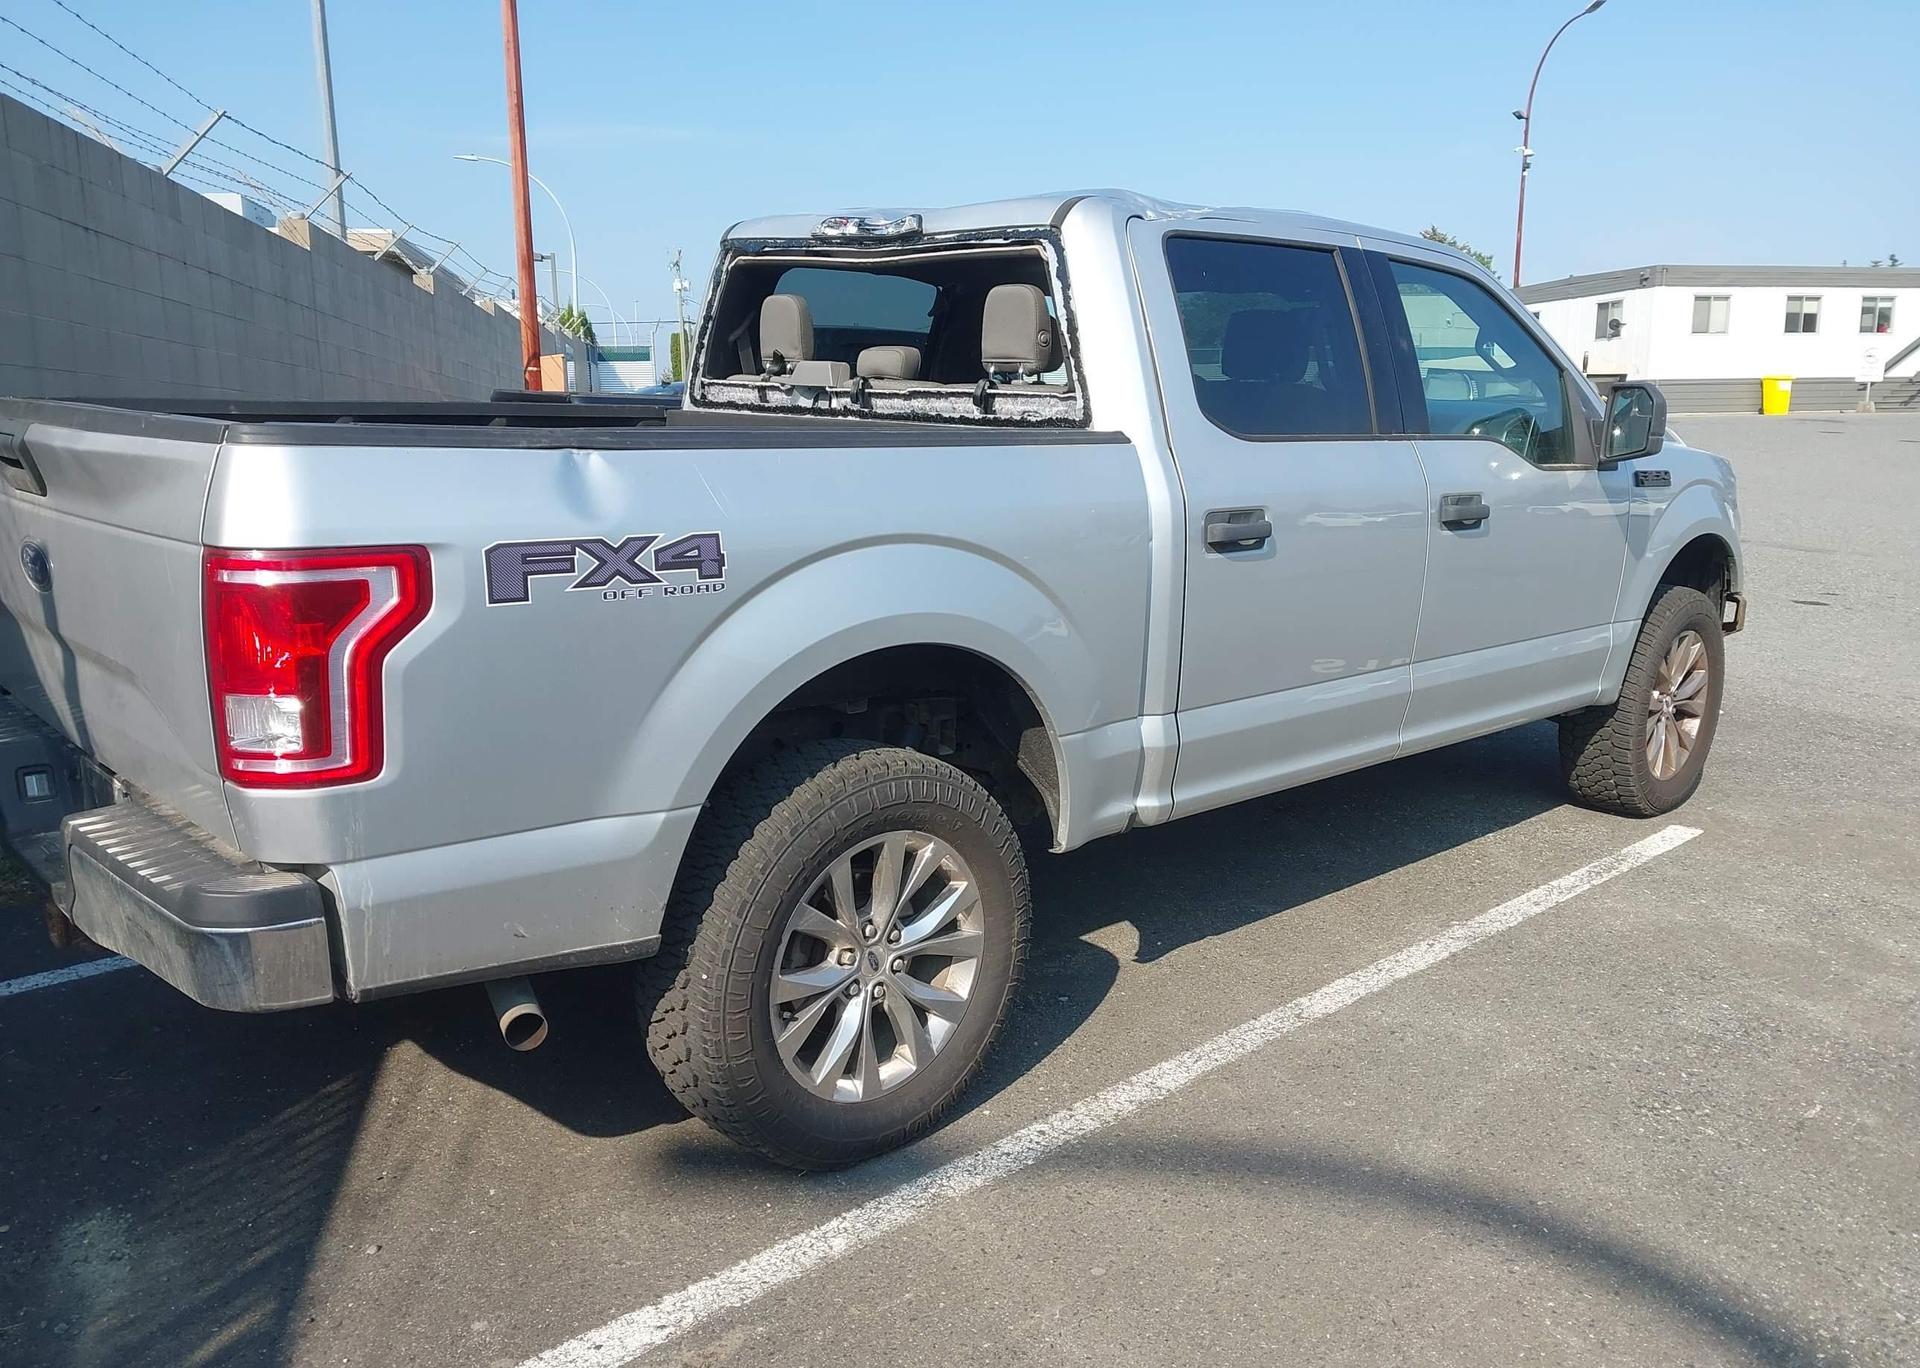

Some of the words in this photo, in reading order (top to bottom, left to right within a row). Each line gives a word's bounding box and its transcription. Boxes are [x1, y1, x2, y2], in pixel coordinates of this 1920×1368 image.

[483, 531, 727, 607] FX4
[602, 588, 654, 601] OFF
[663, 582, 727, 597] ROAD
